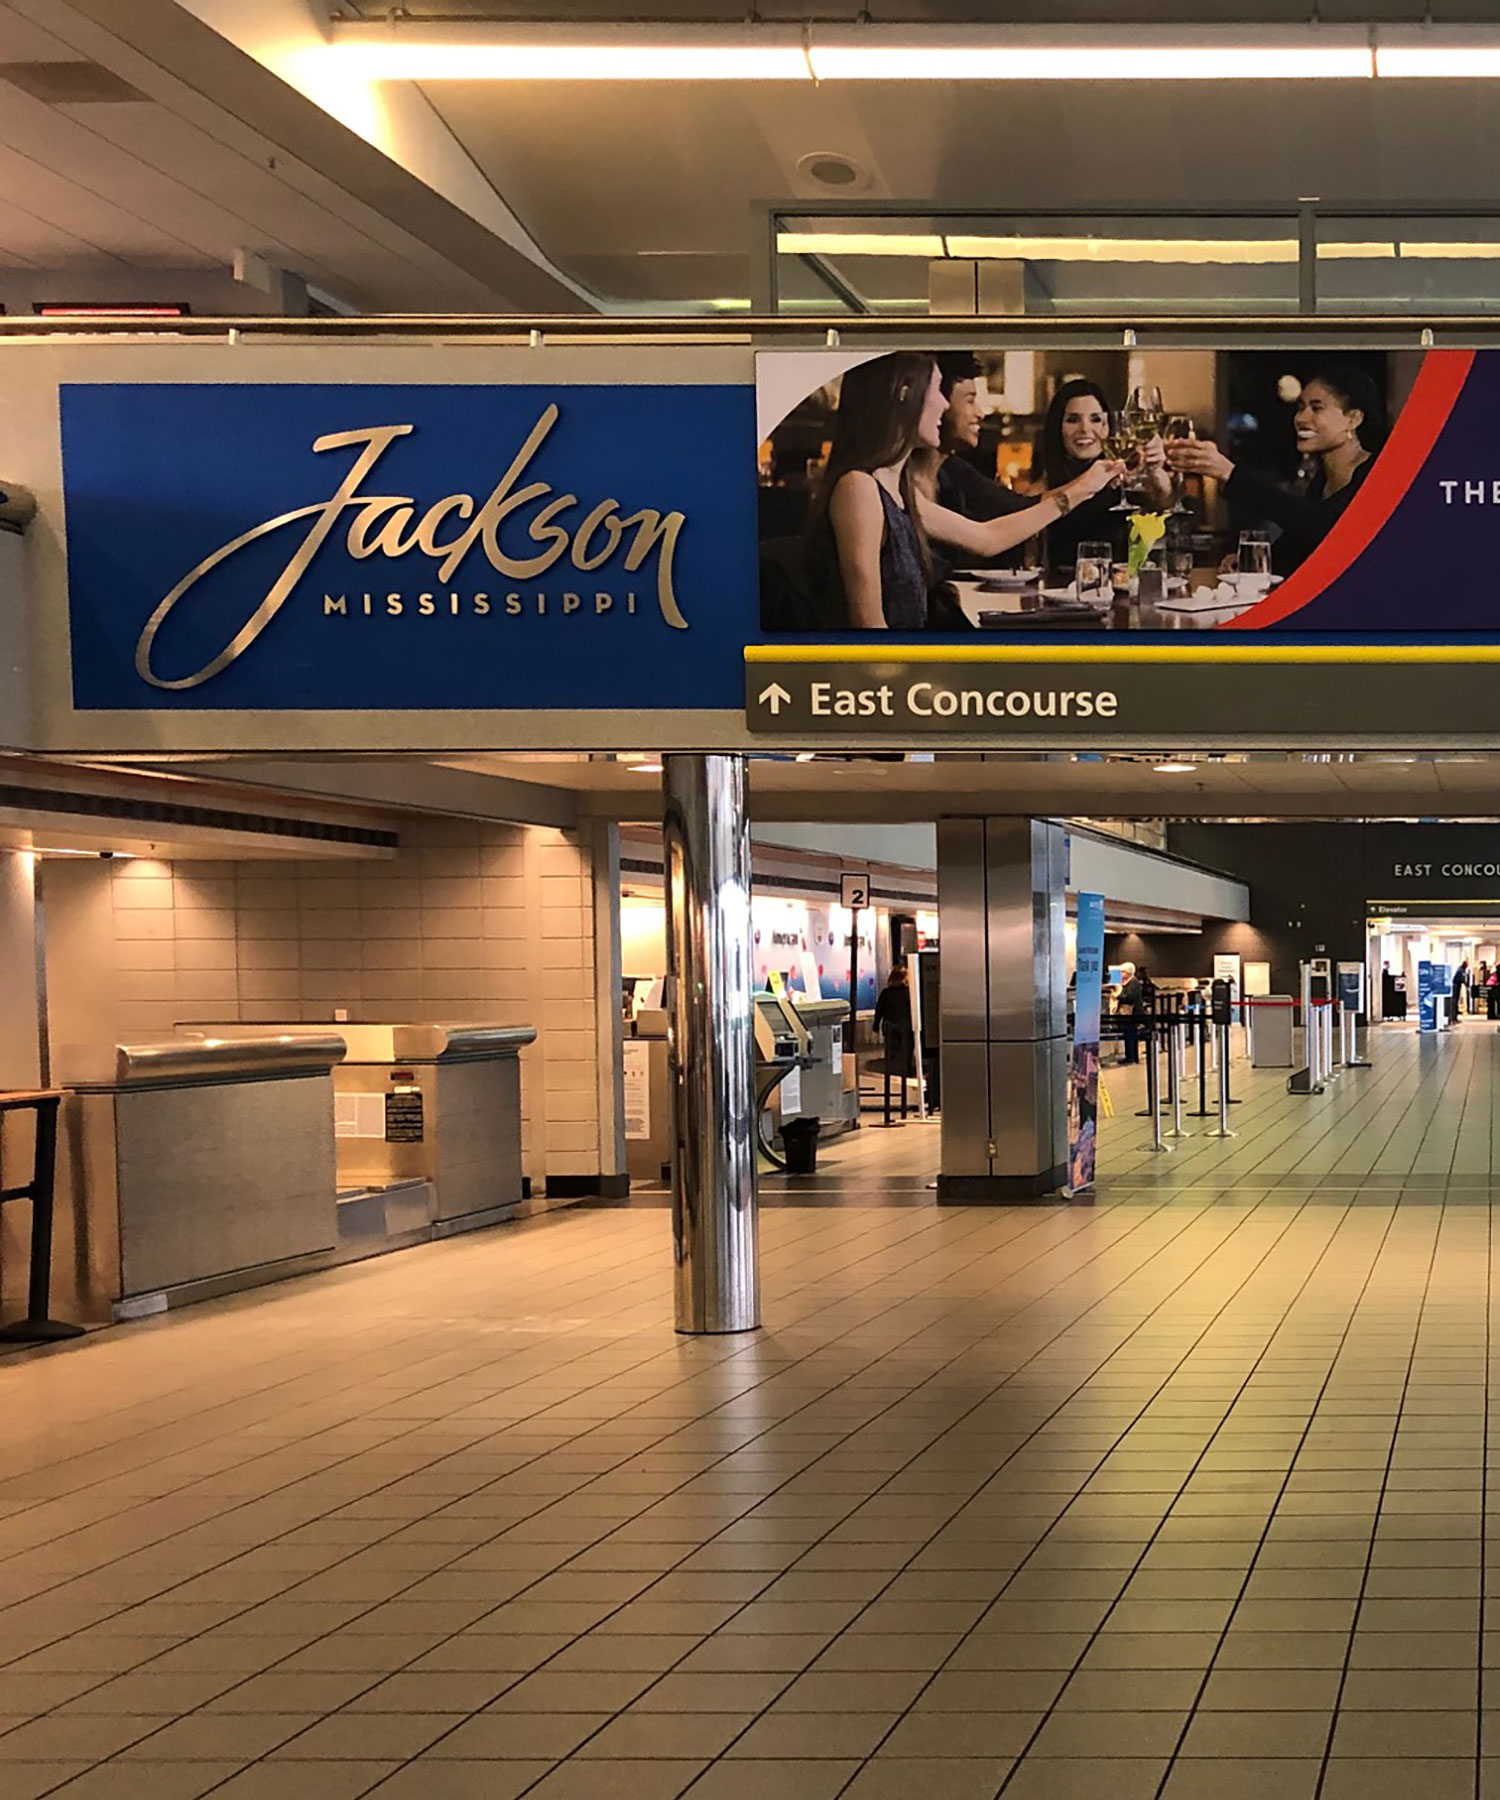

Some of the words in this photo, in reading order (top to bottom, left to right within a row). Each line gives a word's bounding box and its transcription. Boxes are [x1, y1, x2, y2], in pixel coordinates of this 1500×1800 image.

[135, 402, 689, 690] Jackson
[324, 592, 636, 616] MISSISSIPPI
[810, 682, 895, 716] East
[906, 682, 1118, 717] Concourse
[1394, 863, 1432, 877] EAST
[851, 889, 864, 904] 2
